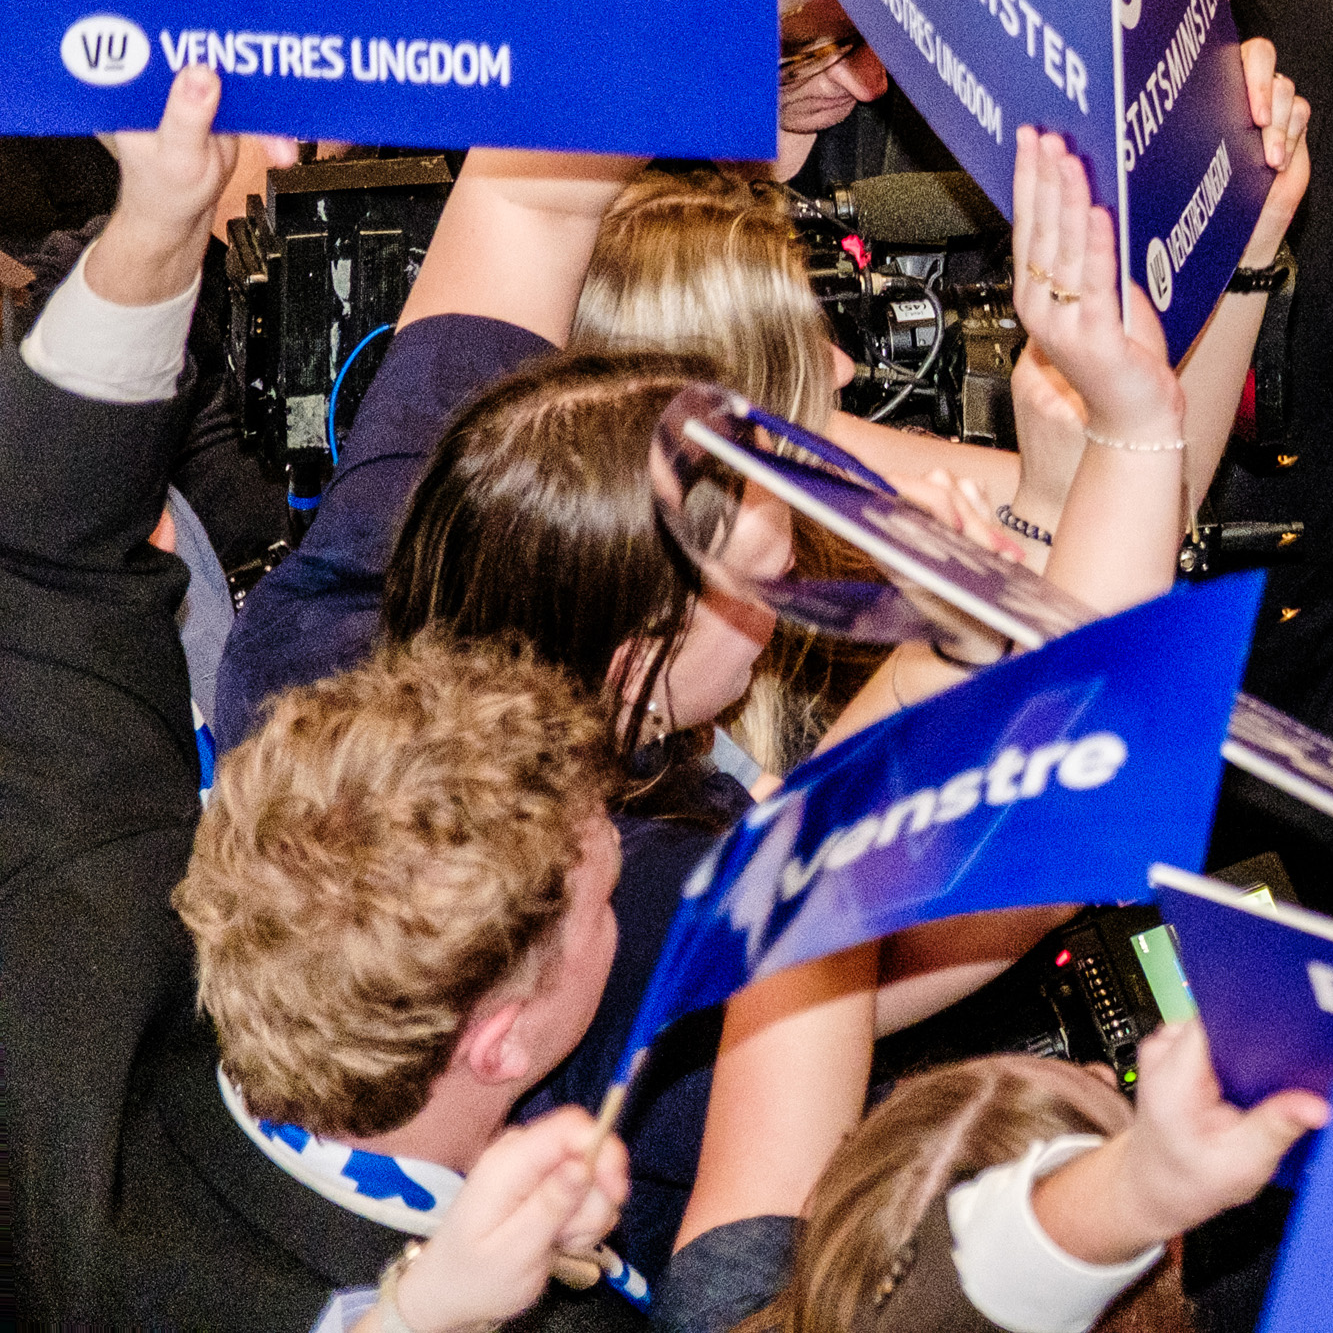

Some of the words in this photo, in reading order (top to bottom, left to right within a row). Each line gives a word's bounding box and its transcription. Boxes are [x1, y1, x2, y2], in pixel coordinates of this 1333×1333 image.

[160, 29, 346, 81] VENSTRES
[350, 37, 512, 88] UNGDOM
[935, 34, 1003, 145] UNGDOM
